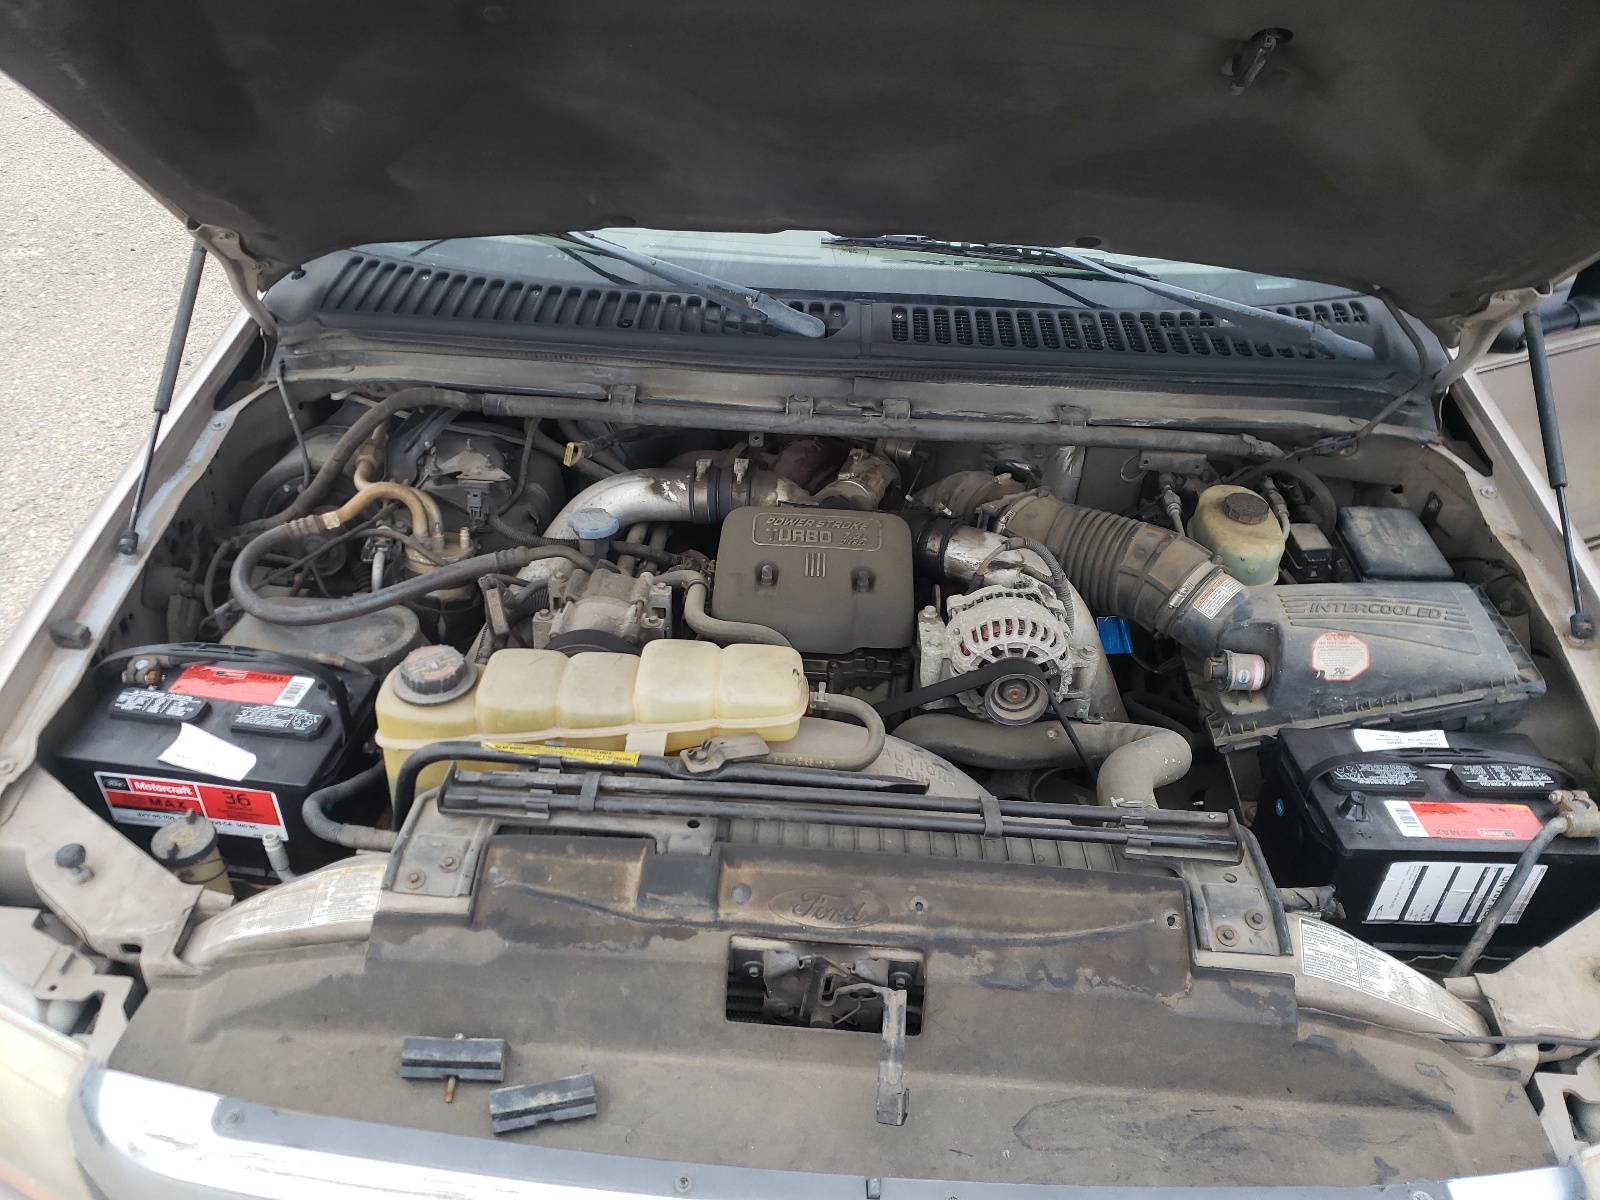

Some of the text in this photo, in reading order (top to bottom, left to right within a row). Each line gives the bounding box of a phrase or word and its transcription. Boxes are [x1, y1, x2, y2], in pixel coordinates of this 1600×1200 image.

[764, 517, 869, 531] POWER STROKE
[765, 528, 832, 543] TURBO
[1309, 602, 1441, 619] INTERCOOLED
[881, 748, 947, 783] AUTION
[895, 763, 923, 782] FAN
[133, 781, 193, 796] Motorcraft
[149, 798, 184, 808] MAX
[222, 791, 251, 806] 36
[791, 889, 866, 922] Ford
